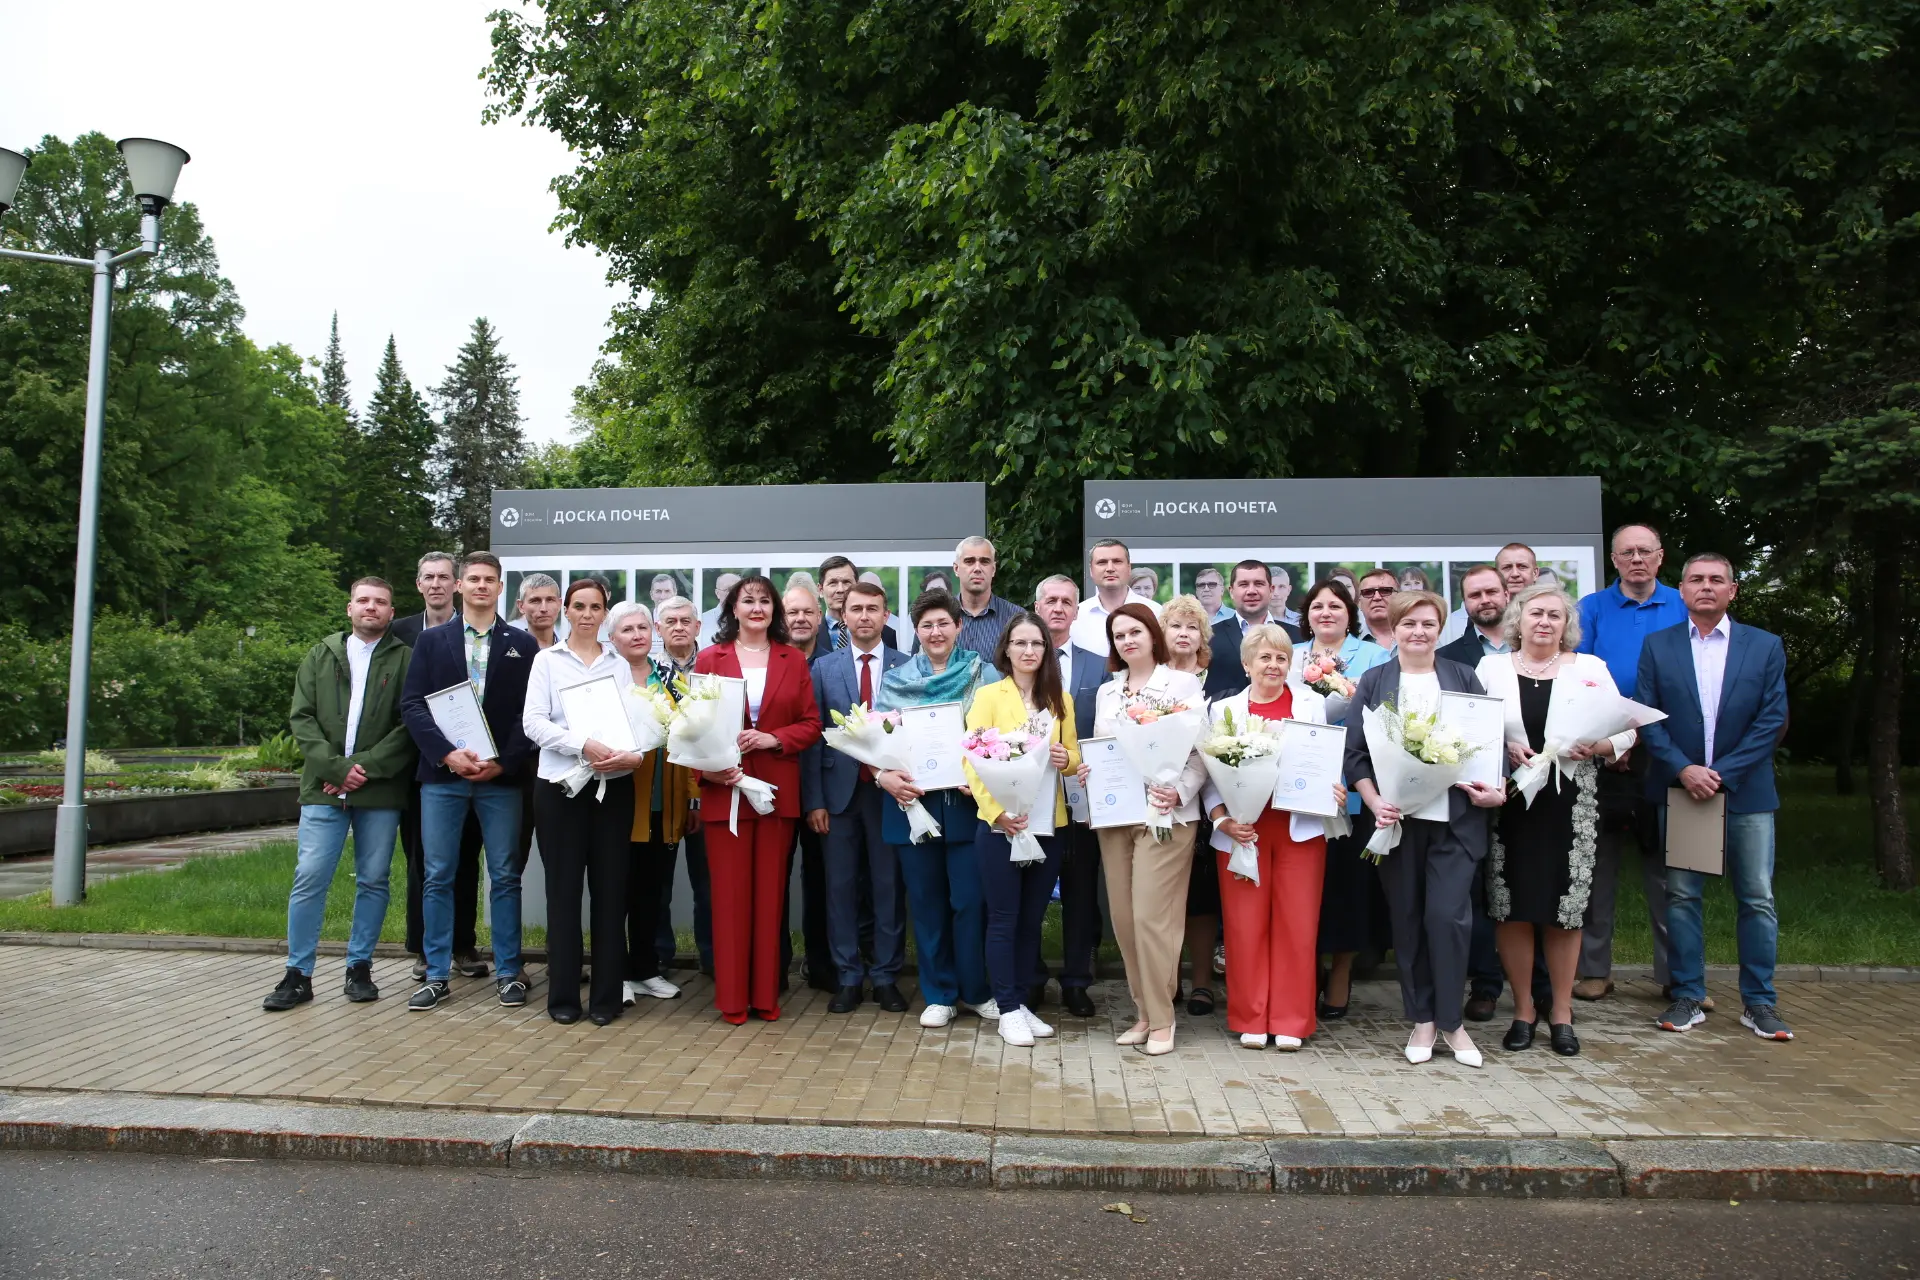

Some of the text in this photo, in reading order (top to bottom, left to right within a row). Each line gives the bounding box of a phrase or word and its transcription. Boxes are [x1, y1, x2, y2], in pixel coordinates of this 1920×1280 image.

[553, 508, 670, 525] ДОСКА ПОЧЕТА
[1153, 501, 1278, 516] ДОСКА ПОЧЕТА
